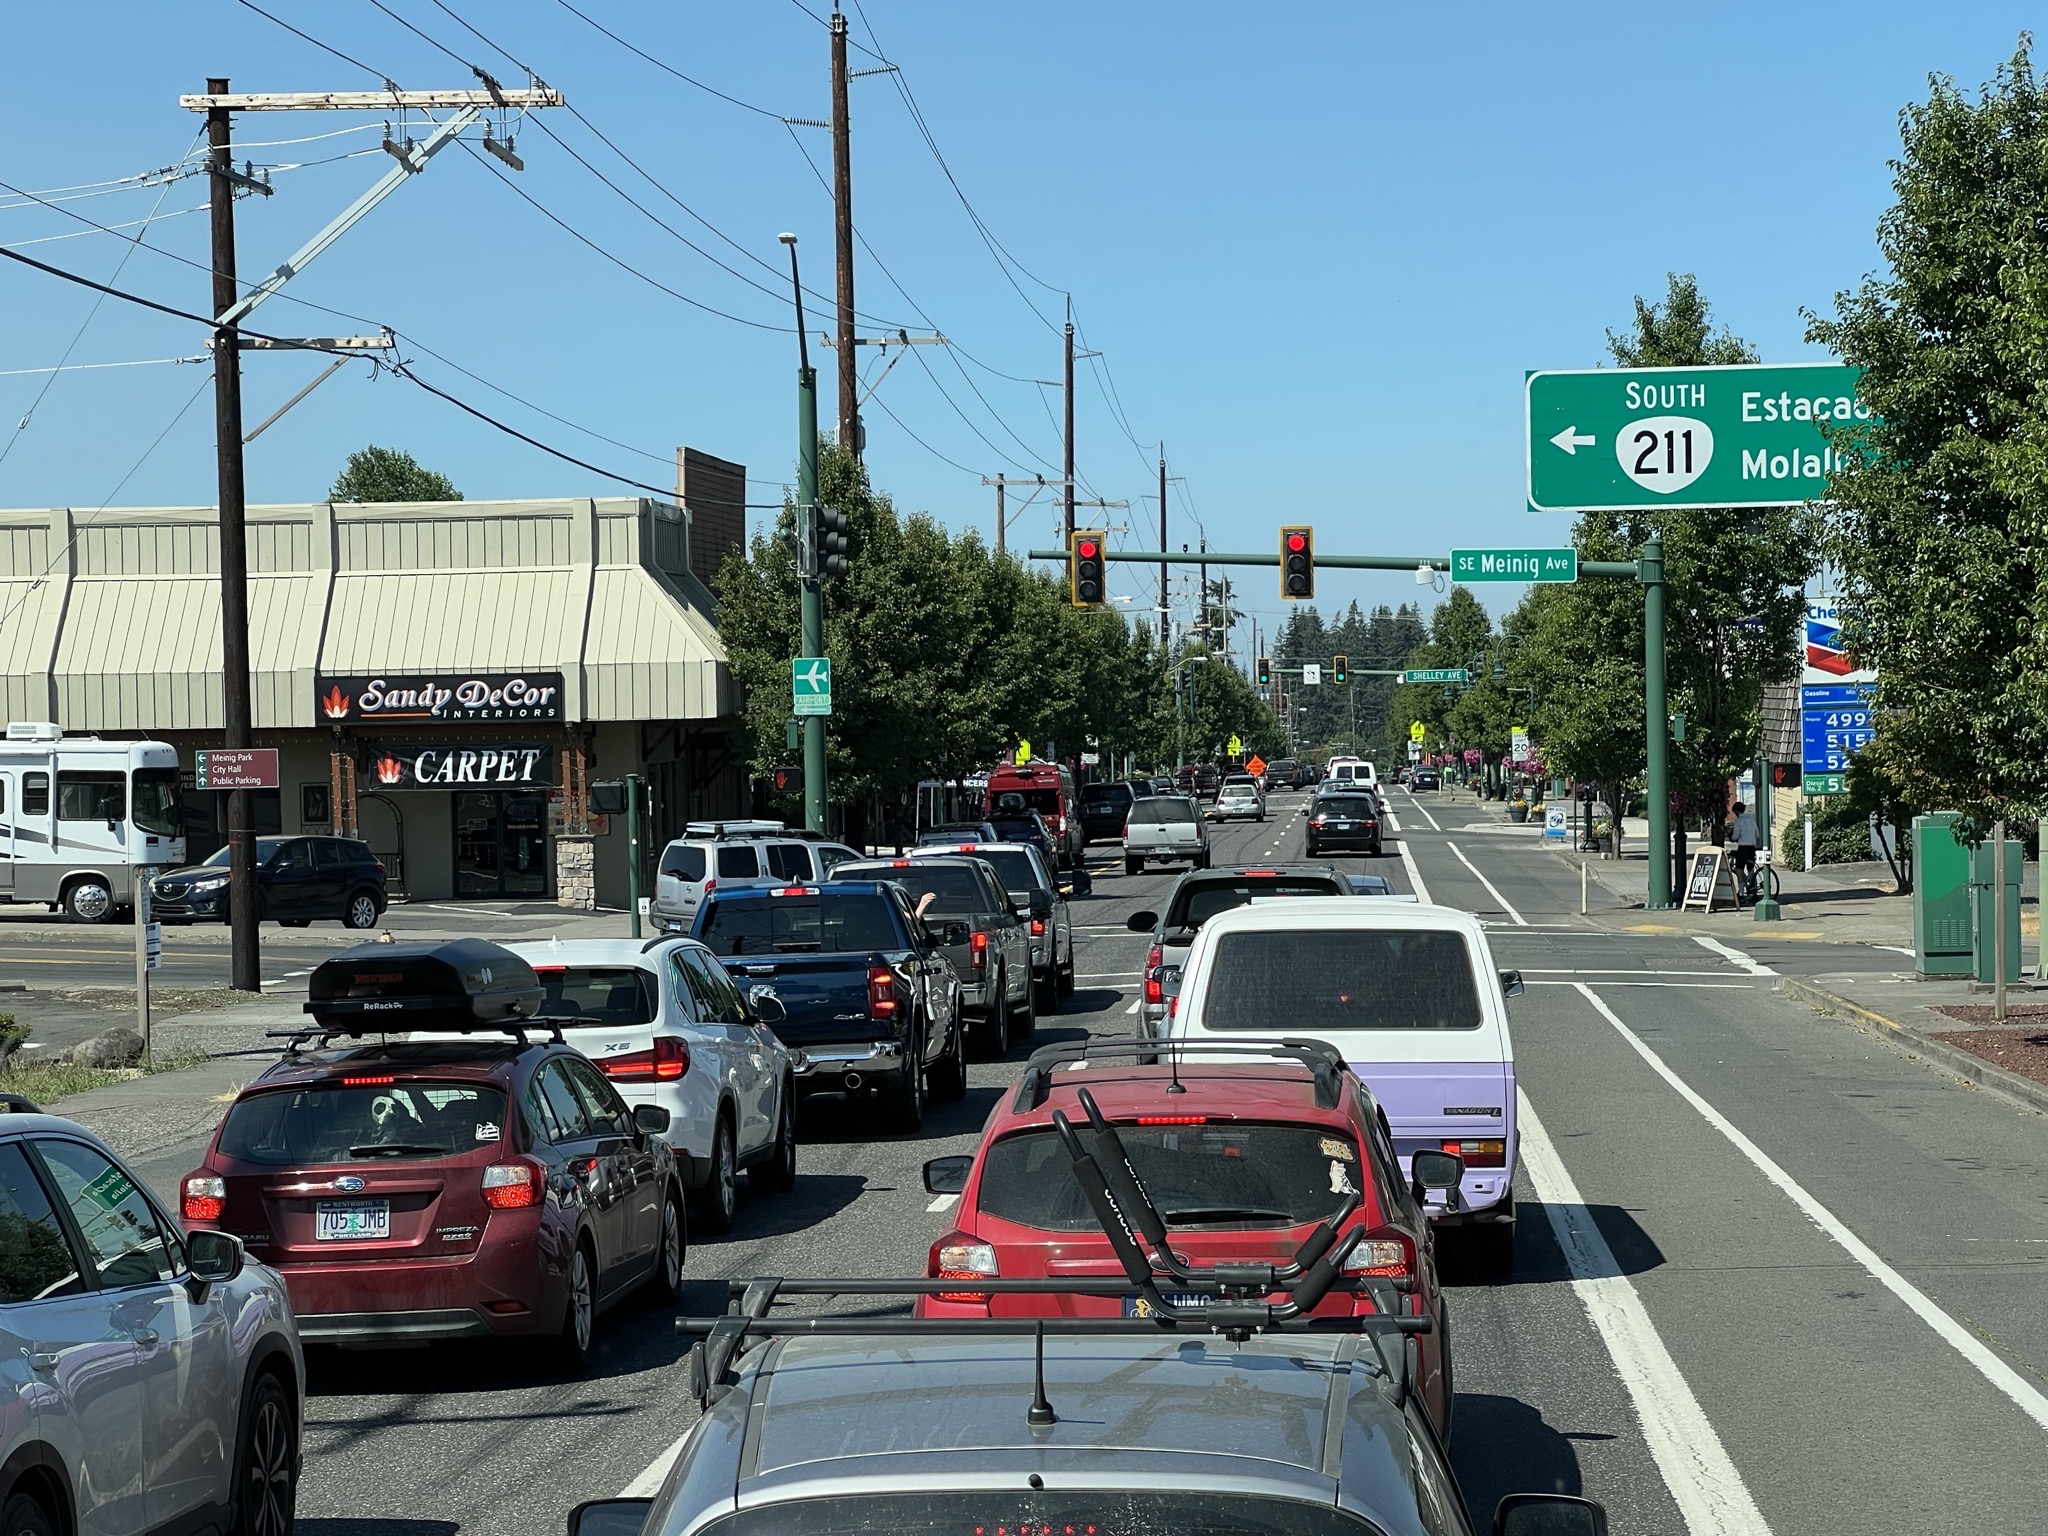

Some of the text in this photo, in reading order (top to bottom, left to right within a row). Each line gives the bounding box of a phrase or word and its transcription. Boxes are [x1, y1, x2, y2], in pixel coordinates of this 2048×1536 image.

[1625, 381, 1706, 409] SOUTH
[1633, 430, 1693, 475] 211
[1742, 448, 1852, 480] Molall
[1459, 554, 1568, 578] SE Meinig Ave
[1807, 606, 1837, 619] Che
[1413, 672, 1461, 680] SHELLEY AVE
[358, 678, 556, 716] Sandy DeCor
[443, 708, 556, 719] INTERIORS
[1826, 713, 1866, 727] 499
[1514, 743, 1528, 752] 20
[212, 753, 253, 763] Meinig Park
[1827, 755, 1852, 769] 52
[212, 765, 242, 775] City Hall
[414, 749, 541, 783] CARPET
[213, 776, 261, 786] Public Parking
[1691, 876, 1712, 893] OPEN
[363, 1002, 394, 1010] ReRack
[604, 1042, 631, 1052] X5
[321, 1209, 386, 1230] 705 JMB
[436, 1226, 480, 1234] IMPREZA
